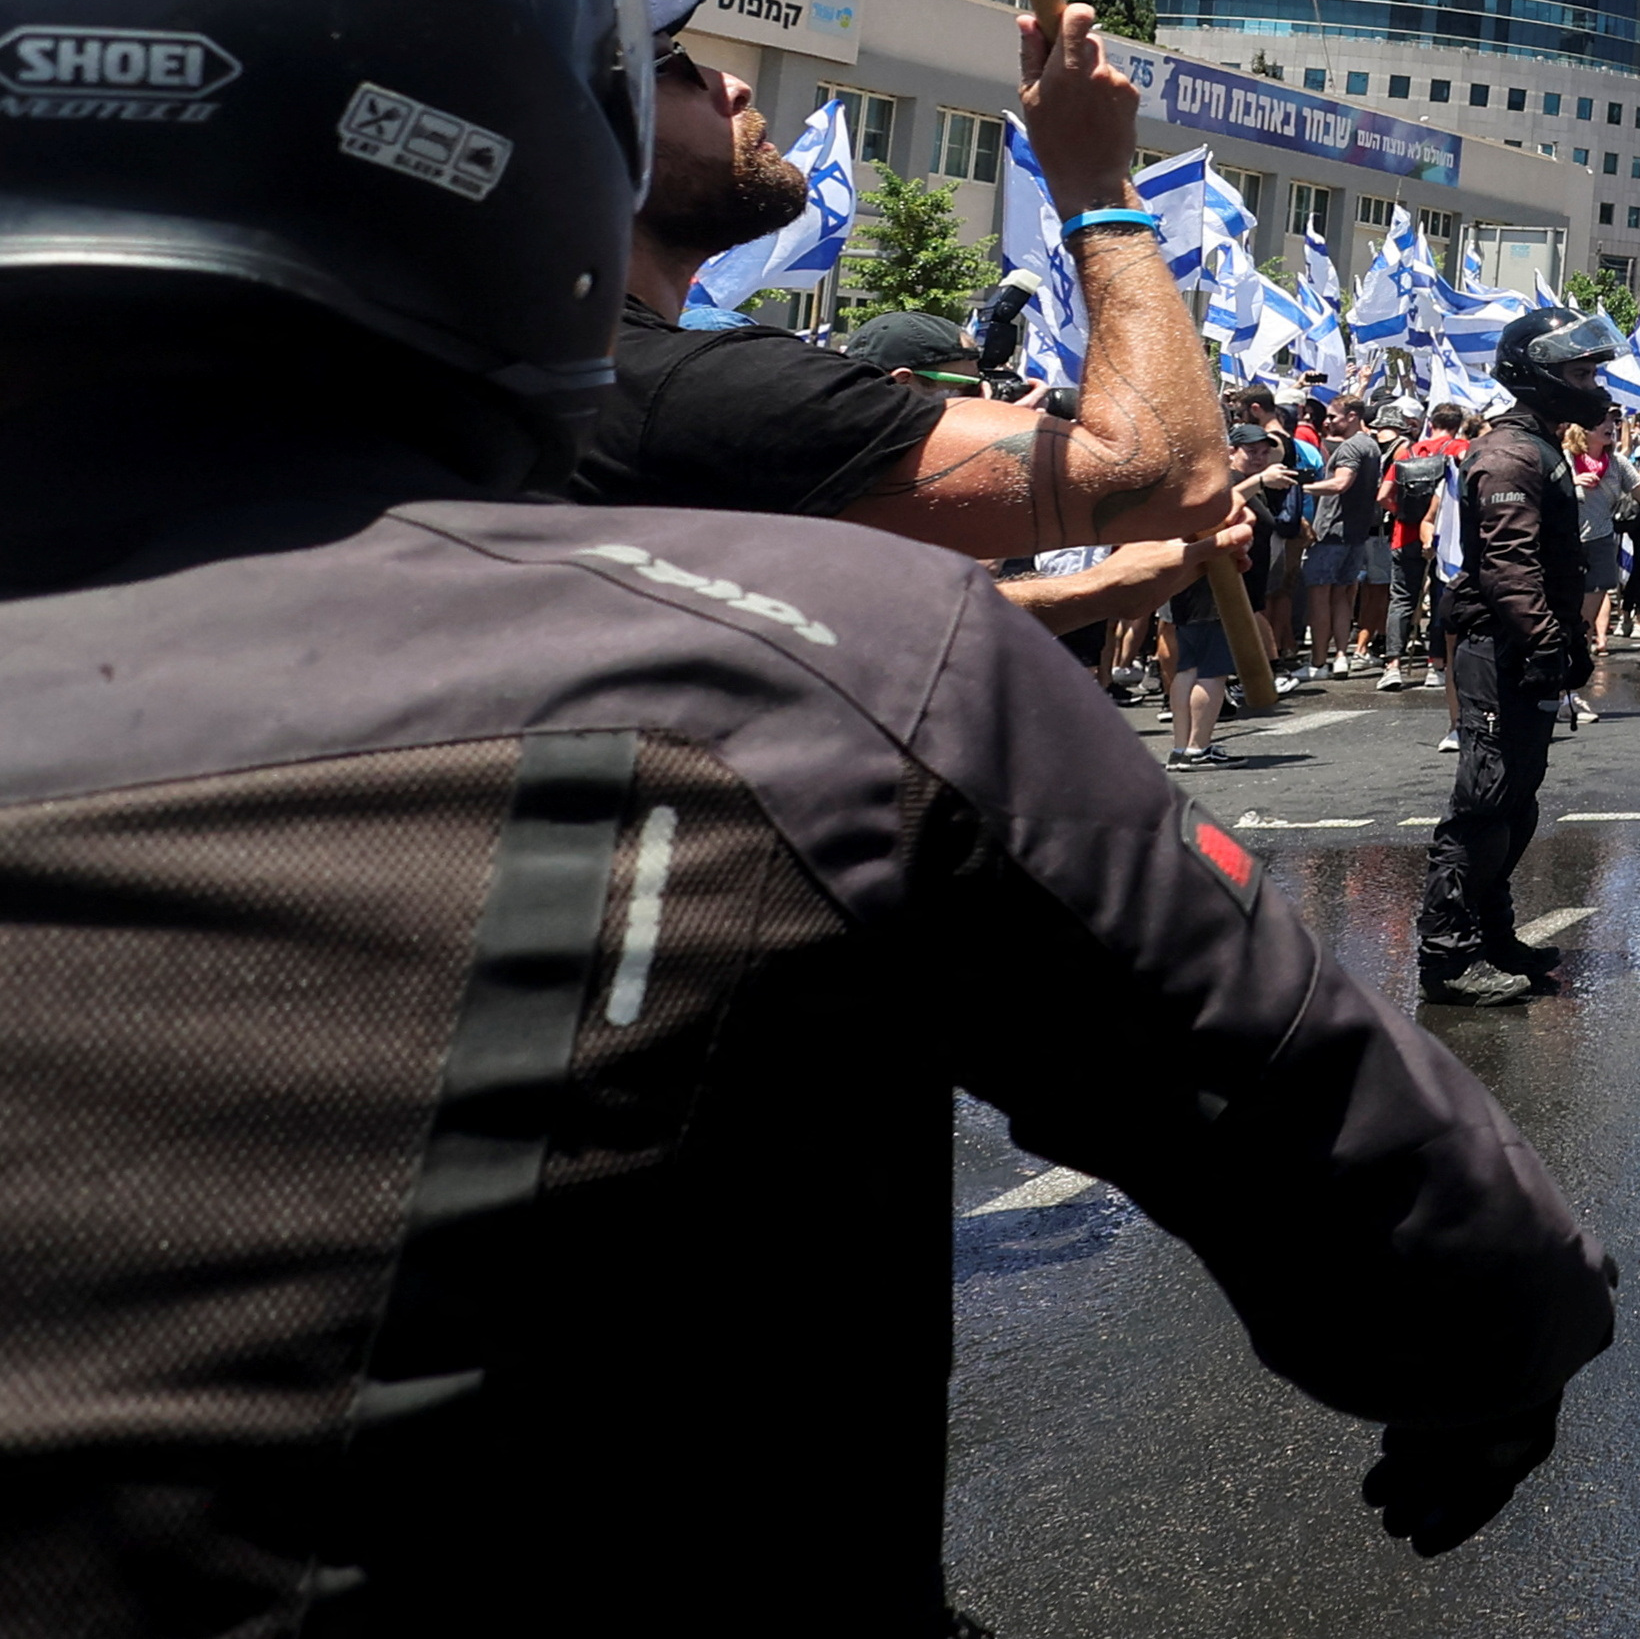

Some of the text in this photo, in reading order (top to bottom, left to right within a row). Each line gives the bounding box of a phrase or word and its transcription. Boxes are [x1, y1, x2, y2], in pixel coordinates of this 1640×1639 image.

[17, 37, 204, 87] SHOEI
[1130, 55, 1154, 88] 75
[1178, 75, 1226, 120] חינם
[1229, 87, 1296, 137] באהבת
[1302, 106, 1352, 149] שבחר
[1357, 129, 1381, 150] העם
[1407, 141, 1422, 160] לא
